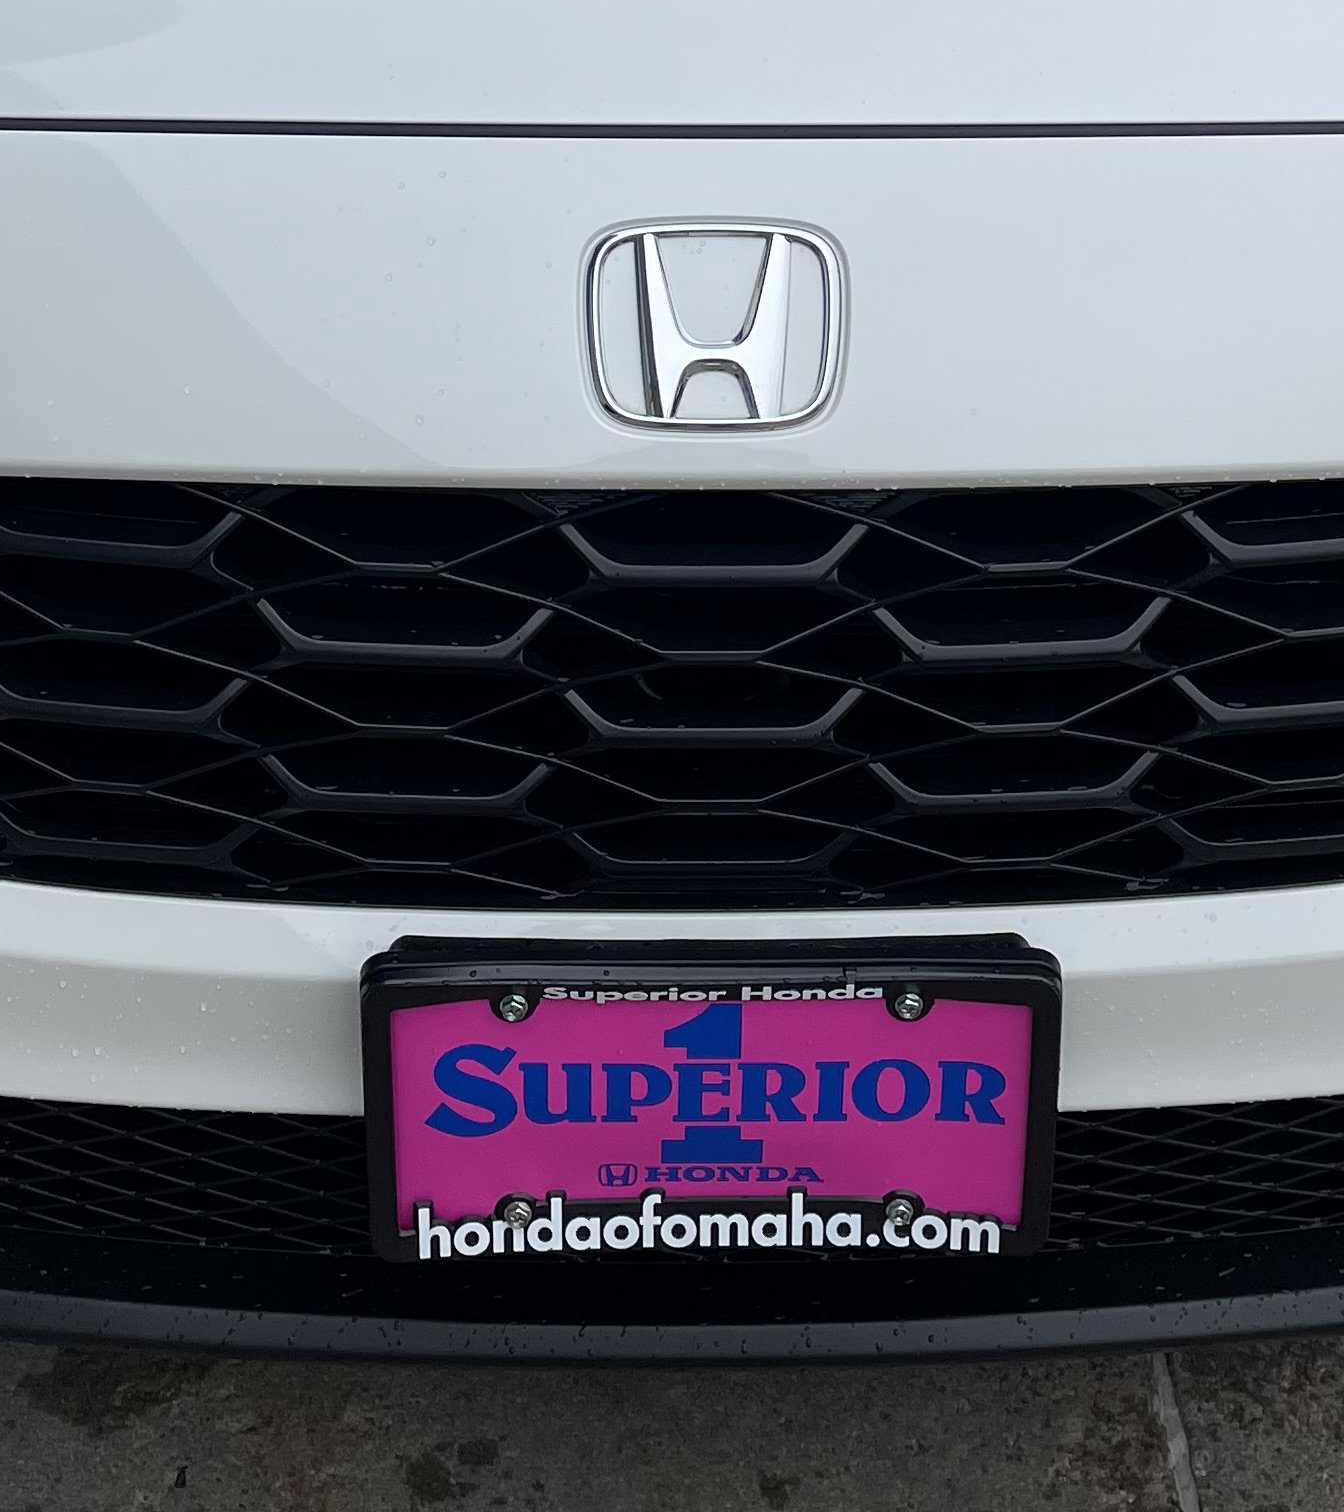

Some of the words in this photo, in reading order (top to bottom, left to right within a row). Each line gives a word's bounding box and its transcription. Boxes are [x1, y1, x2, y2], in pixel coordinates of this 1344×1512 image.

[542, 986, 727, 1005] Superior
[741, 984, 884, 1001] Honda
[425, 1042, 1007, 1138] SUPERIOR
[644, 1166, 824, 1183] HONDA
[417, 1192, 1001, 1261] hondaofomaha.com
